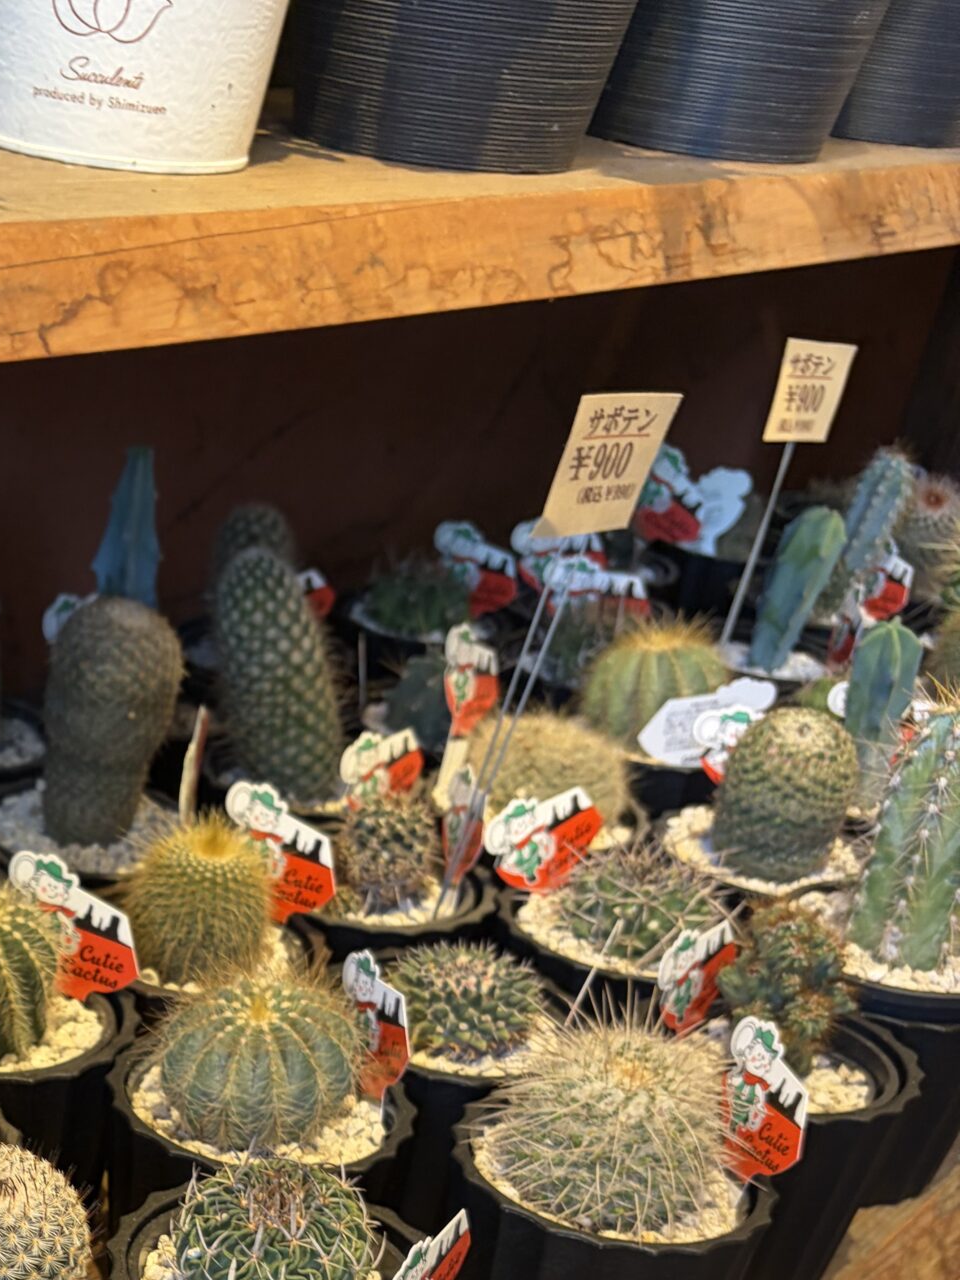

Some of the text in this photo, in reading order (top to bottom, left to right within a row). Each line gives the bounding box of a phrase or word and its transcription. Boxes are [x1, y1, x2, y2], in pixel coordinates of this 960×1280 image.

[32, 86, 85, 105] produced
[89, 92, 103, 110] by
[789, 353, 837, 376] サボテン
[588, 405, 658, 436] サボテン
[569, 441, 634, 481] ¥900
[80, 945, 124, 974] Cutie
[759, 1122, 790, 1156] Cutie
